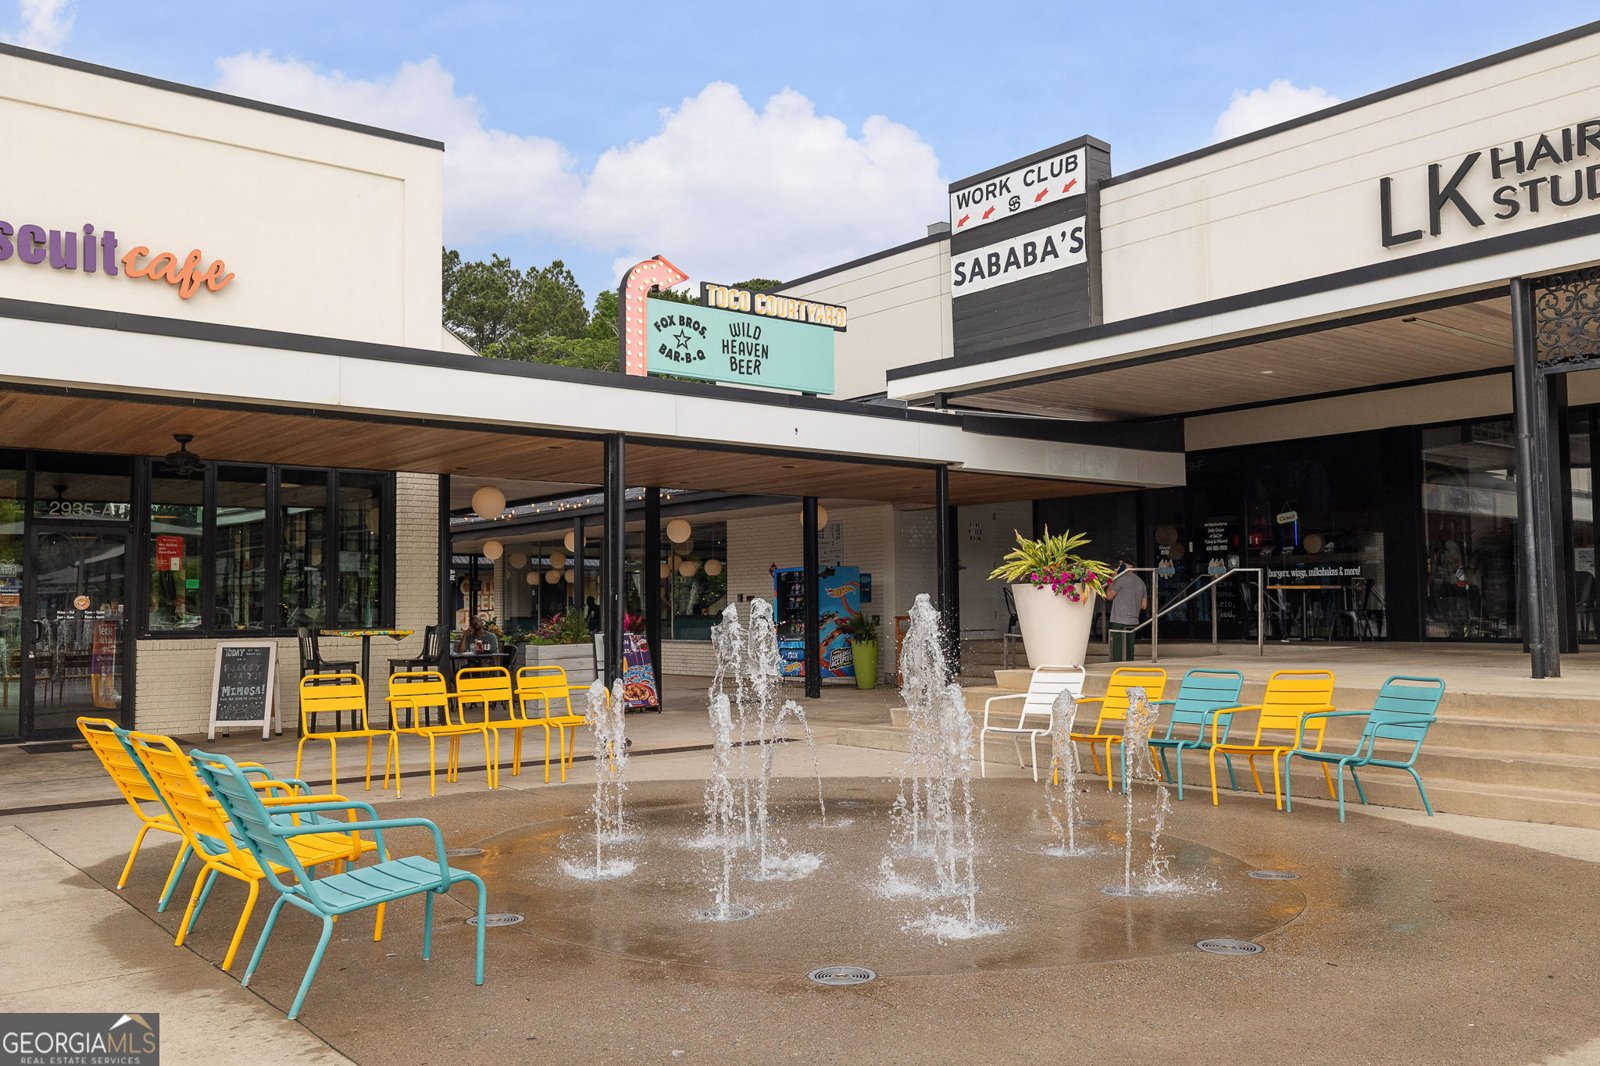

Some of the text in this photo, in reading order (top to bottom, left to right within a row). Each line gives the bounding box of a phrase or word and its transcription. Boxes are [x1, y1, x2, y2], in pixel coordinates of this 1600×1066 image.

[1490, 119, 1600, 179] HAIR
[956, 154, 1078, 210] WORK CLUB
[1380, 151, 1486, 248] LK
[953, 226, 1084, 287] SABABA'S
[121, 246, 235, 300] cafe
[705, 284, 846, 328] TOCO COURTYARD
[653, 315, 707, 339] FOX BROS.
[728, 322, 762, 341] WILD
[658, 343, 706, 363] BAR-B-Q
[722, 339, 769, 360] HEAVEN
[729, 356, 762, 375] BEER
[1268, 568, 1290, 579] burgers,
[1291, 568, 1307, 579] wings,
[1308, 567, 1338, 577] milkshakes
[1338, 566, 1344, 576] &
[224, 648, 246, 657] TODAY
